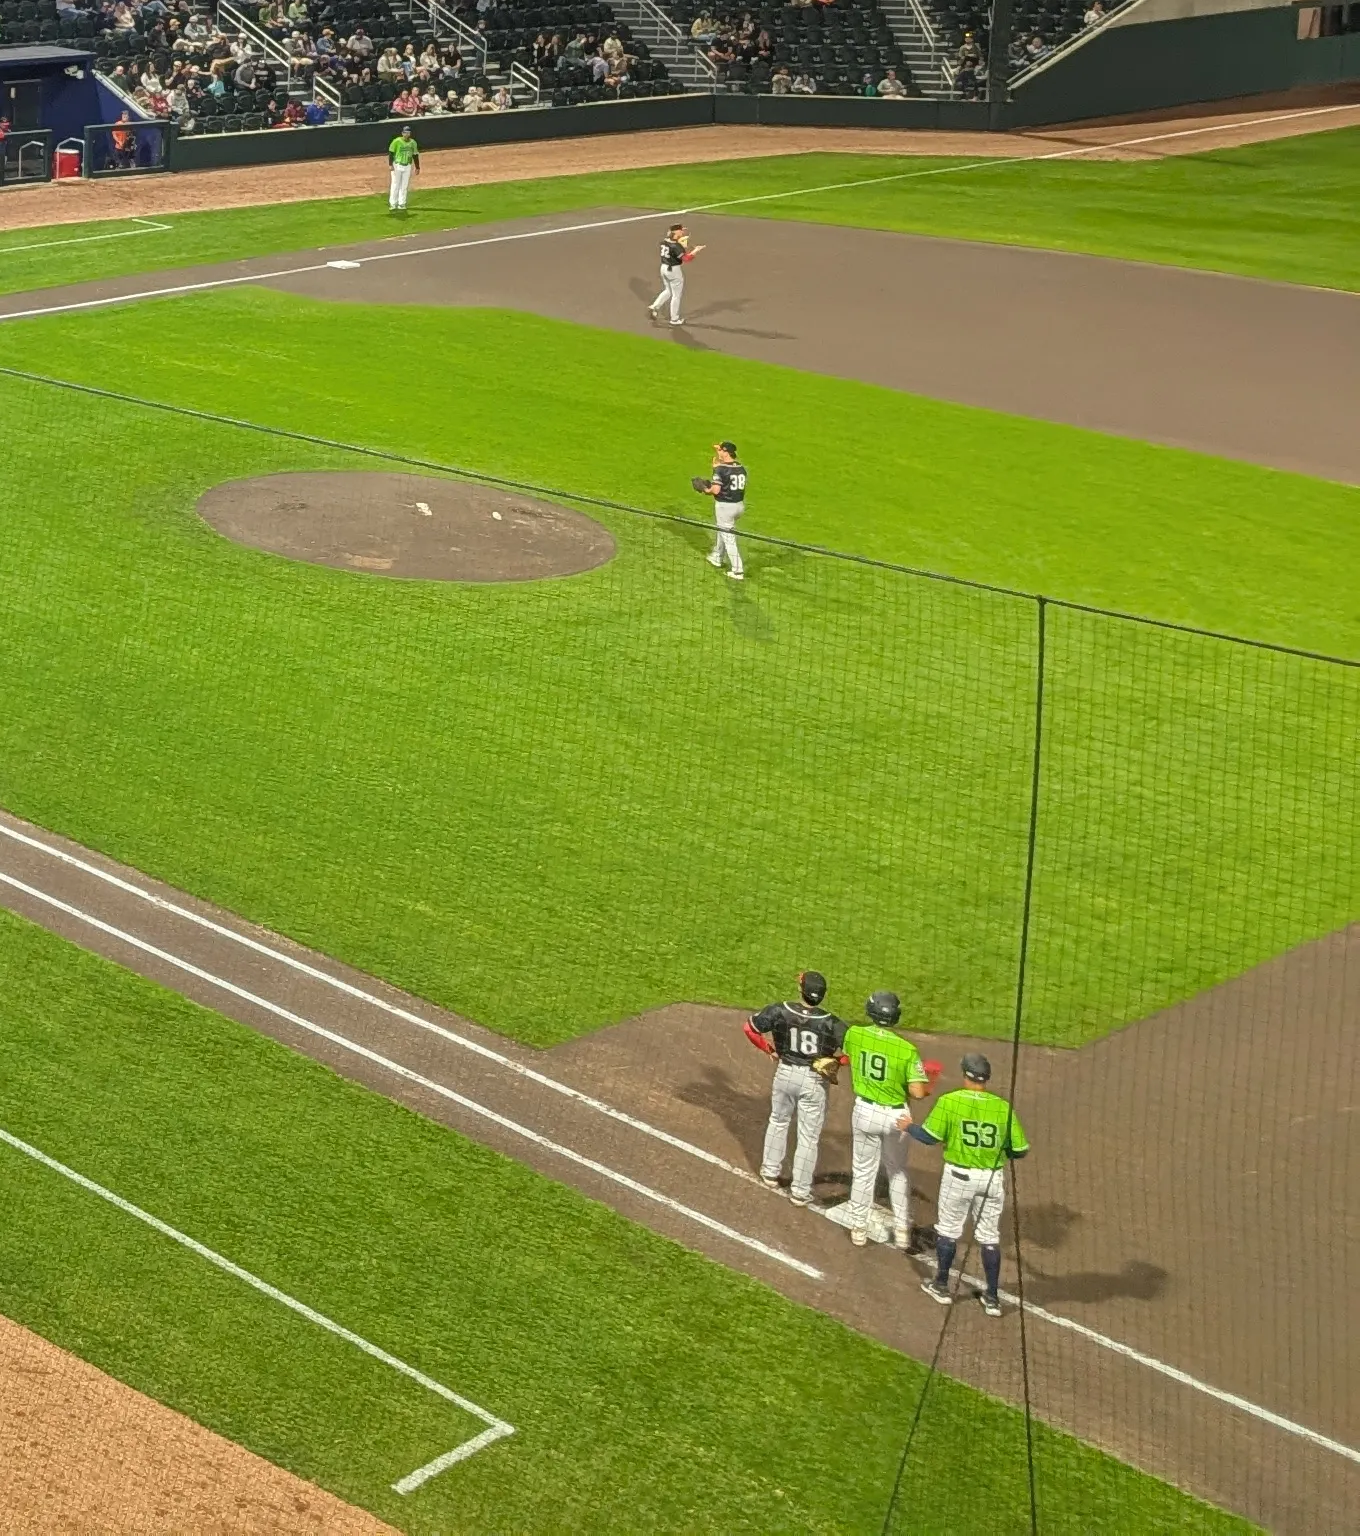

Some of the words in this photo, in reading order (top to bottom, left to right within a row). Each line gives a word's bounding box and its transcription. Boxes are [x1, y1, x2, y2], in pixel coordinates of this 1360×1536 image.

[730, 473, 746, 491] 38
[789, 1027, 818, 1055] 18
[859, 1050, 889, 1082] 19
[961, 1120, 998, 1149] 53
